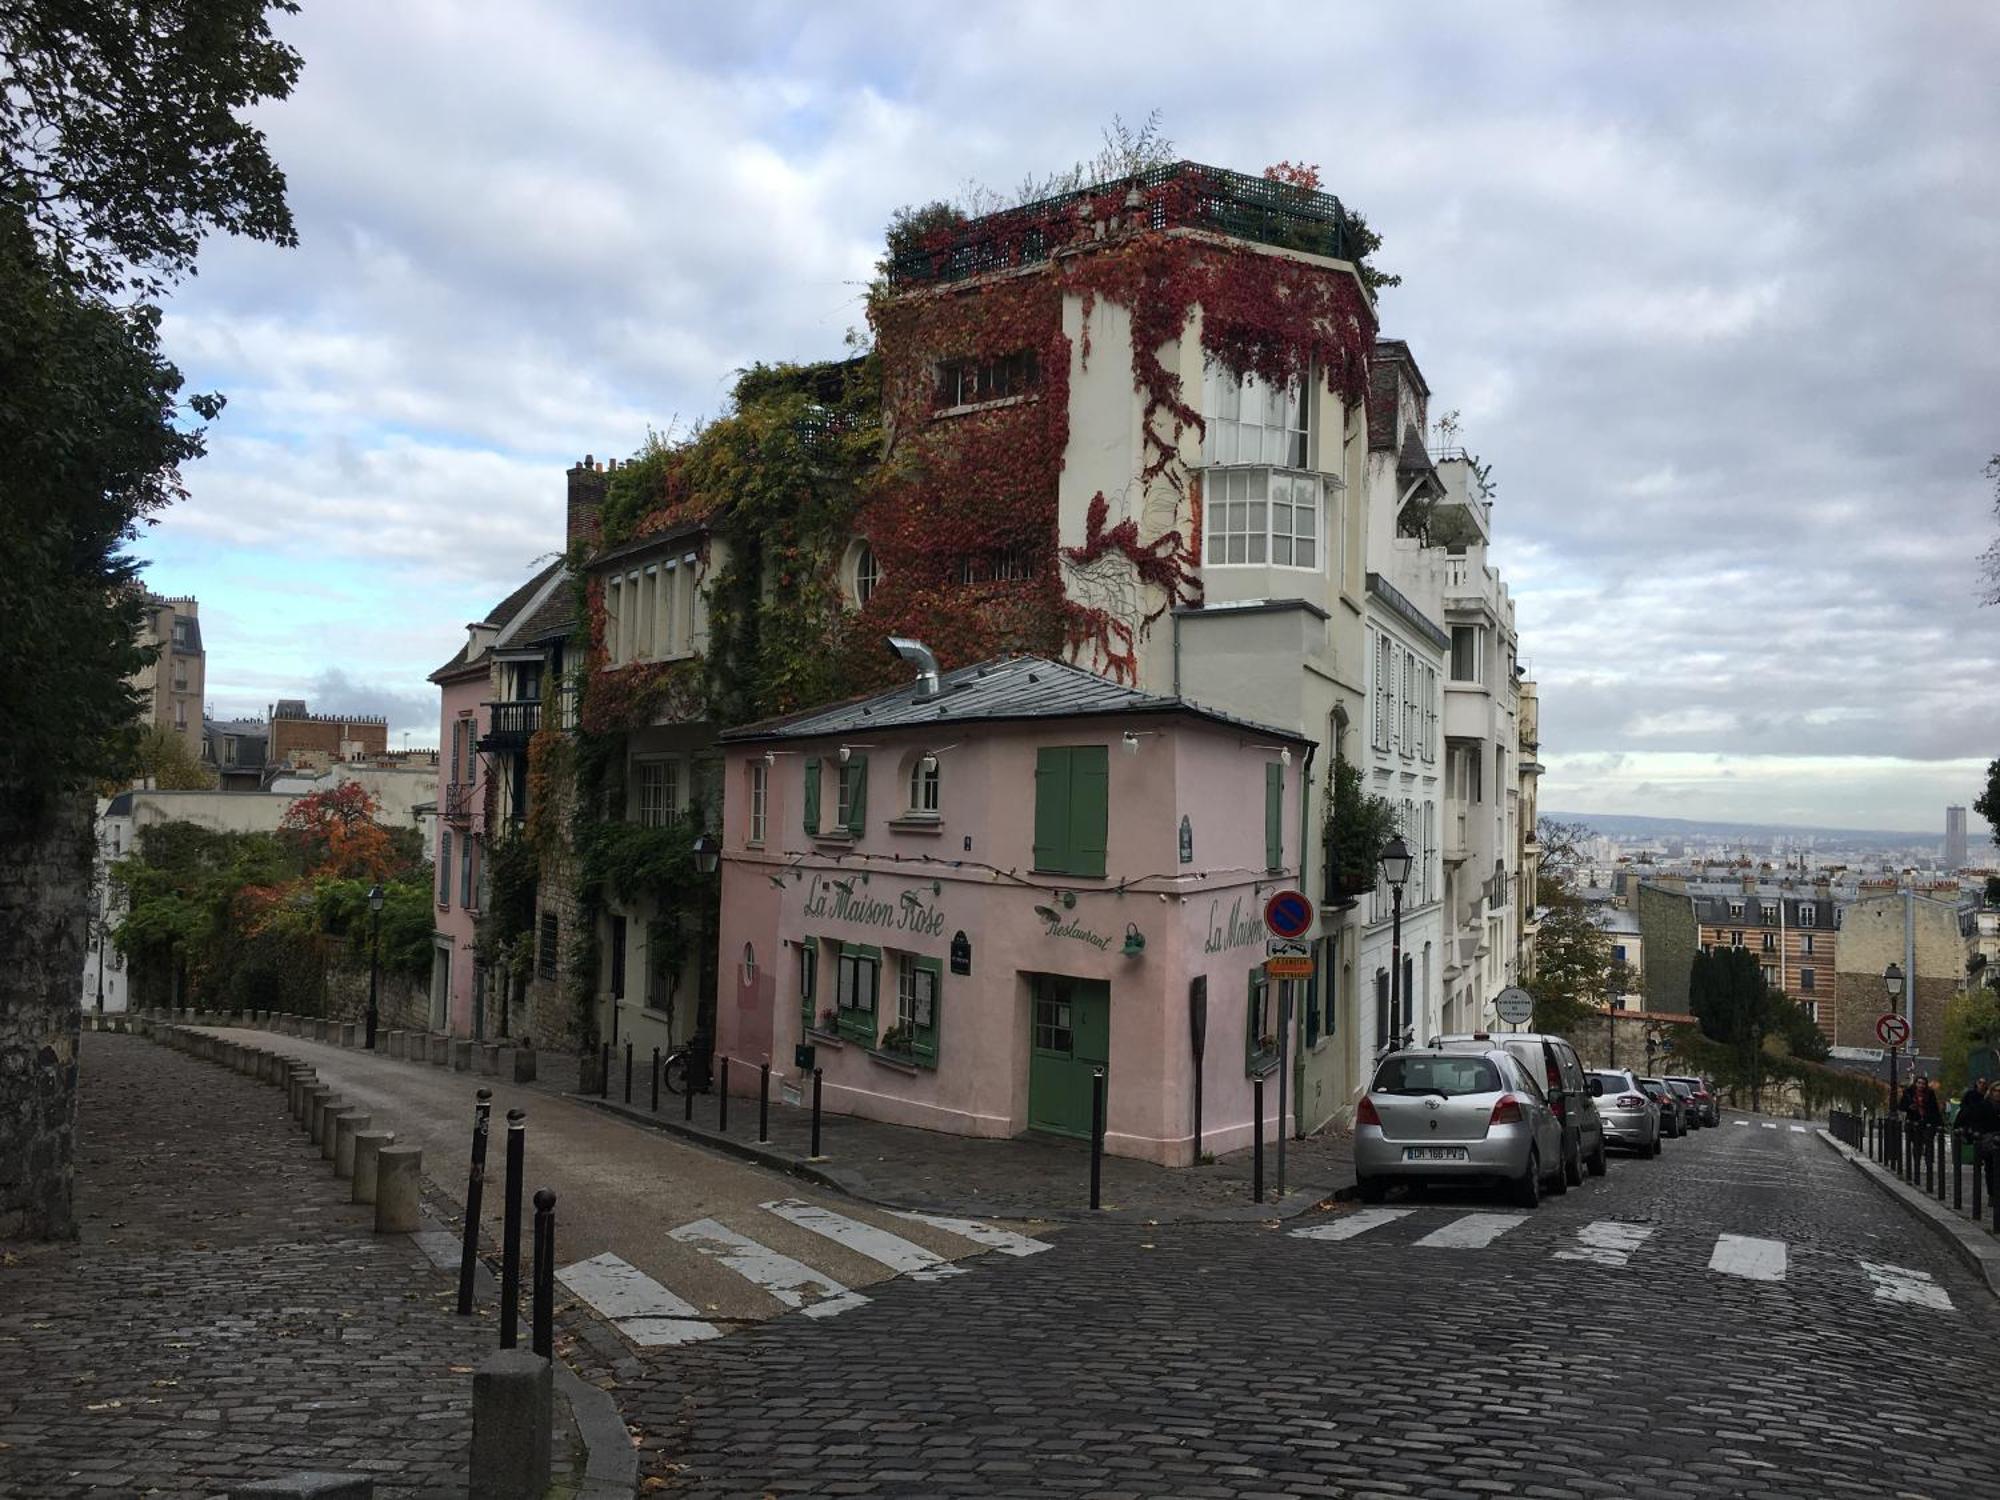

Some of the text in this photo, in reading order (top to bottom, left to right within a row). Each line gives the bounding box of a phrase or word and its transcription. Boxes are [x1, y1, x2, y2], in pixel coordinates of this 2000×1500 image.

[804, 874, 945, 937] La Maison Rose
[1045, 918, 1113, 951] Restaurant
[1205, 895, 1269, 954] La Maison
